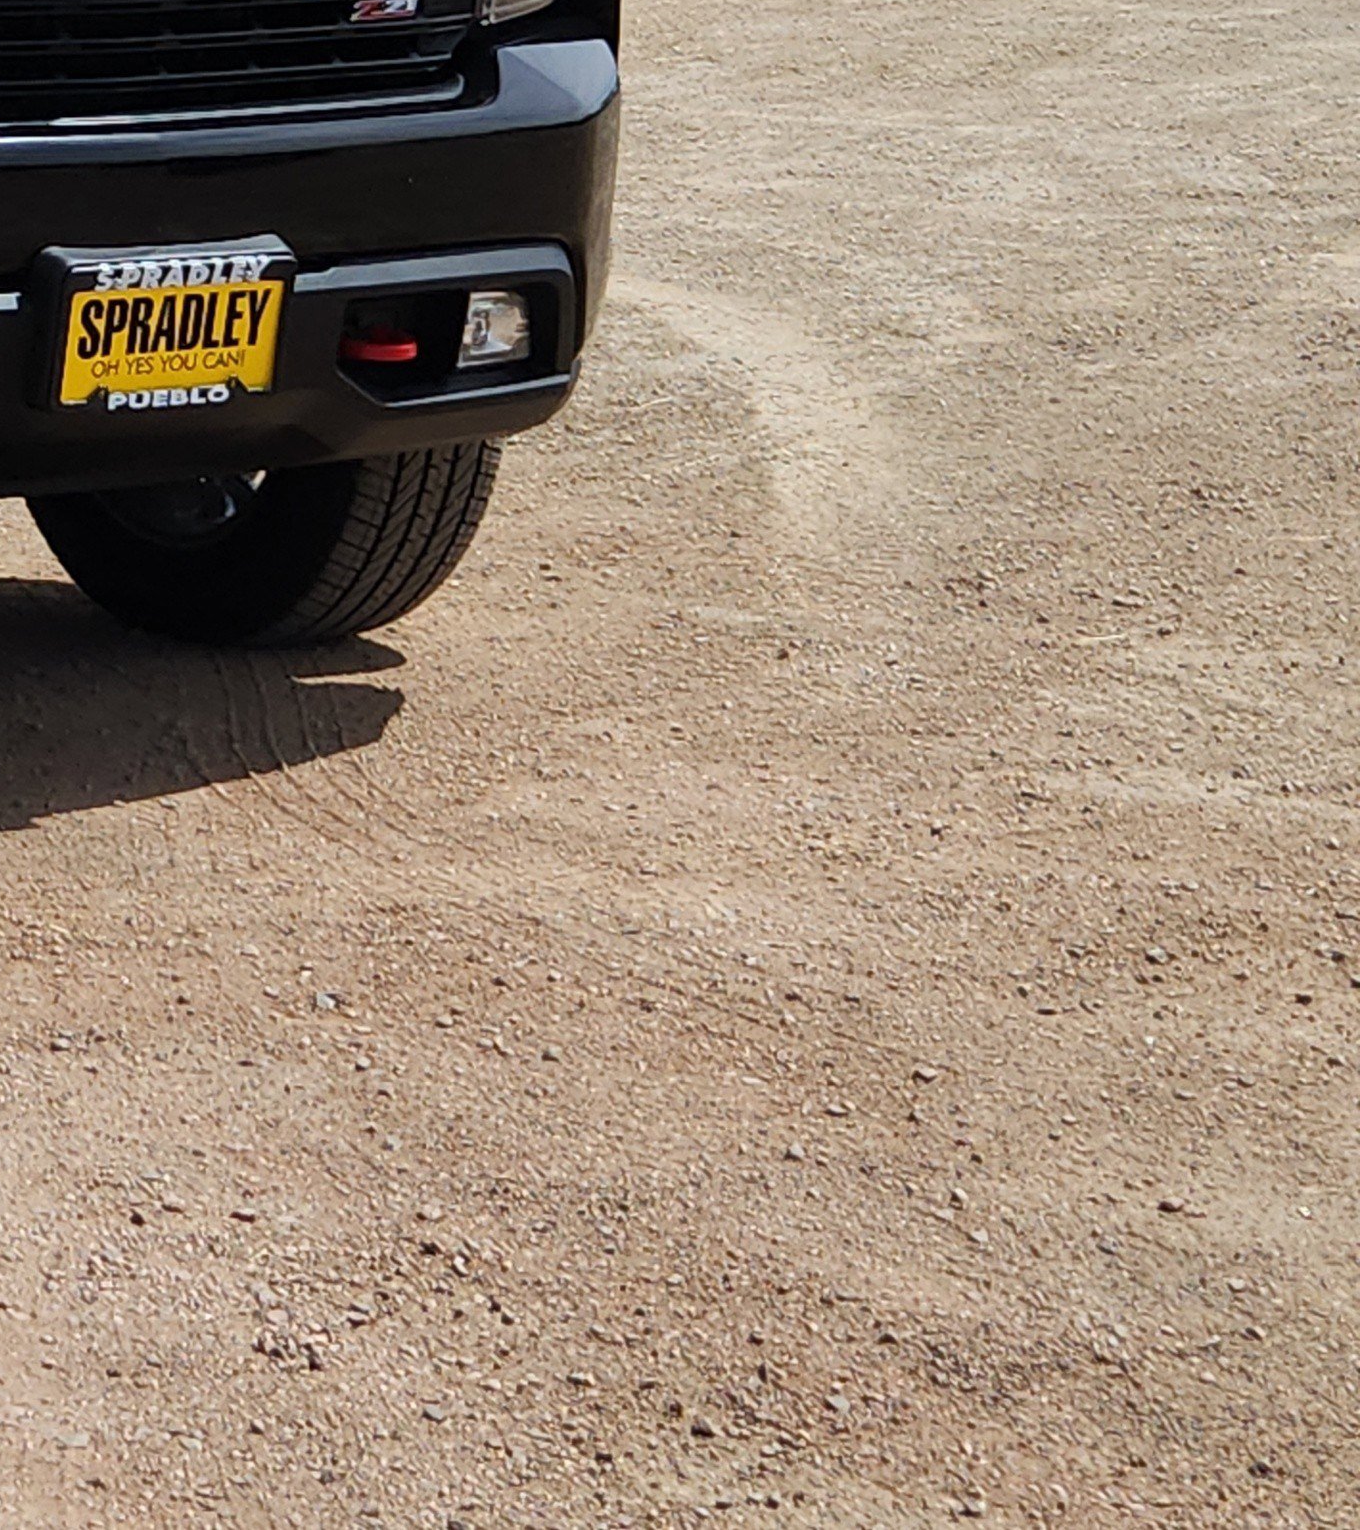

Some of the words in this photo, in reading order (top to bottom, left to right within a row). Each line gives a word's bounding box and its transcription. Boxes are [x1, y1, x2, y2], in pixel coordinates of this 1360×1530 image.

[95, 255, 269, 290] SPRADLEY
[77, 289, 271, 359] SPRADLEY
[91, 359, 120, 378] OH
[125, 356, 154, 375] YES
[159, 353, 198, 371] YOU
[202, 350, 246, 370] CAN!
[108, 385, 229, 411] PUEBLO
